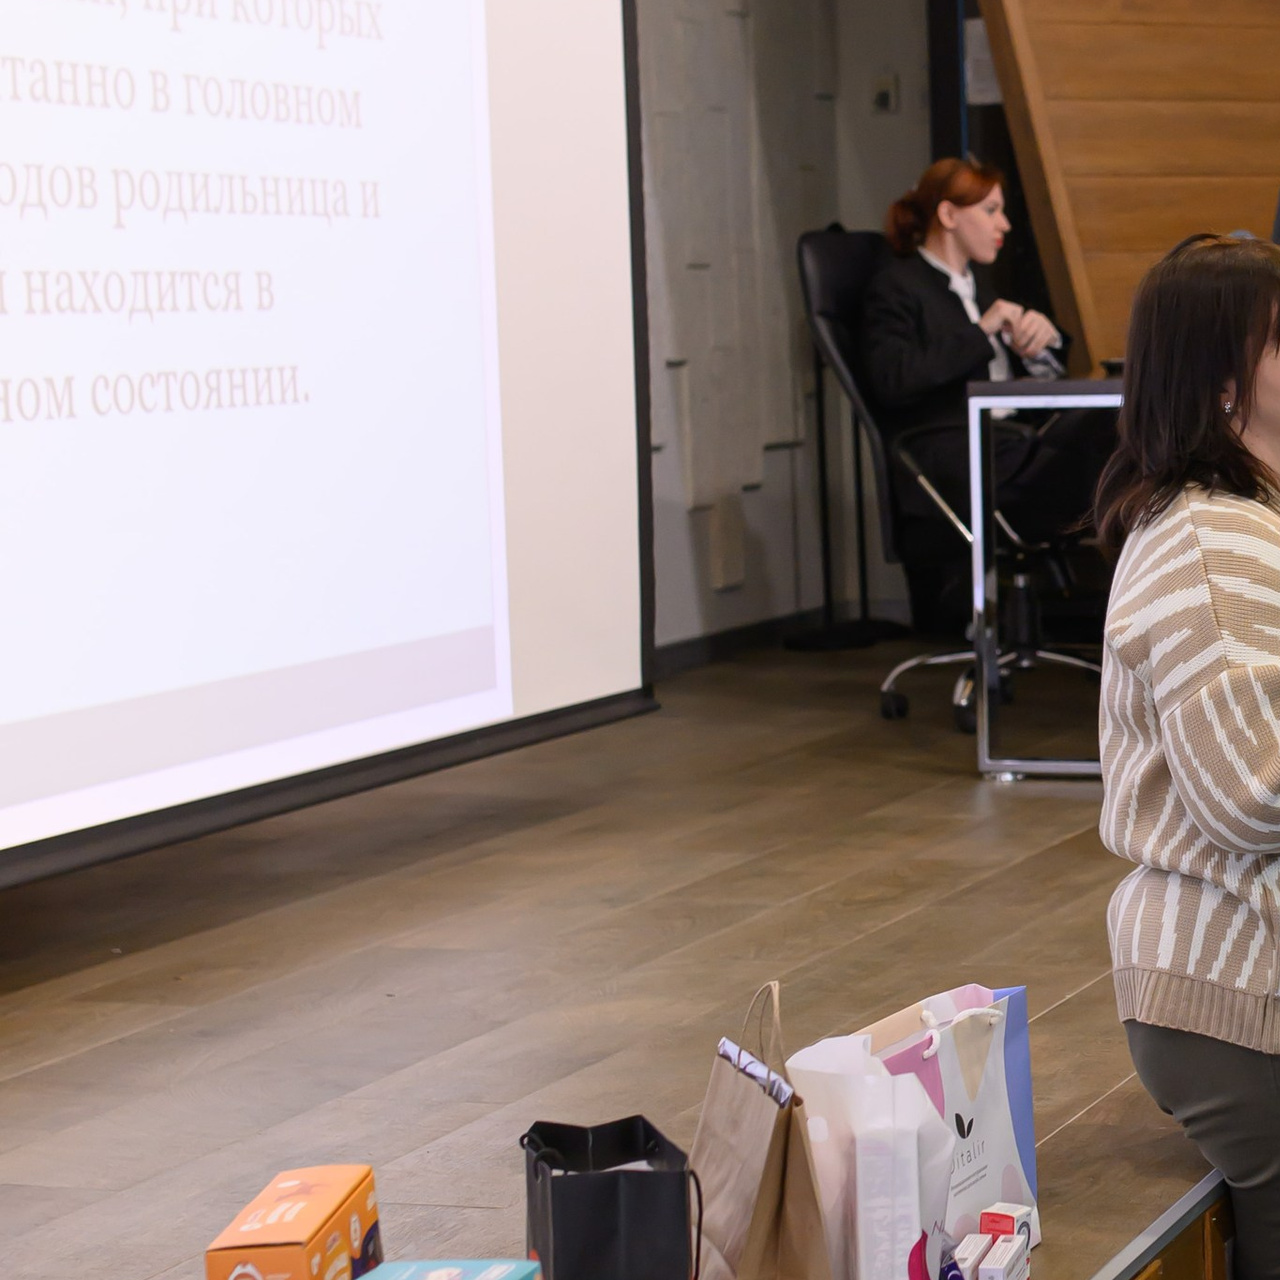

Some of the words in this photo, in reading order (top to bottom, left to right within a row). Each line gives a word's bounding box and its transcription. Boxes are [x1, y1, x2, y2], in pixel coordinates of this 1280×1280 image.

[150, 69, 171, 113] в
[183, 73, 363, 129] головном
[112, 168, 351, 230] родильница
[360, 180, 381, 219] и
[25, 269, 243, 326] находится
[256, 270, 275, 312] в
[91, 365, 310, 416] состоянии.
